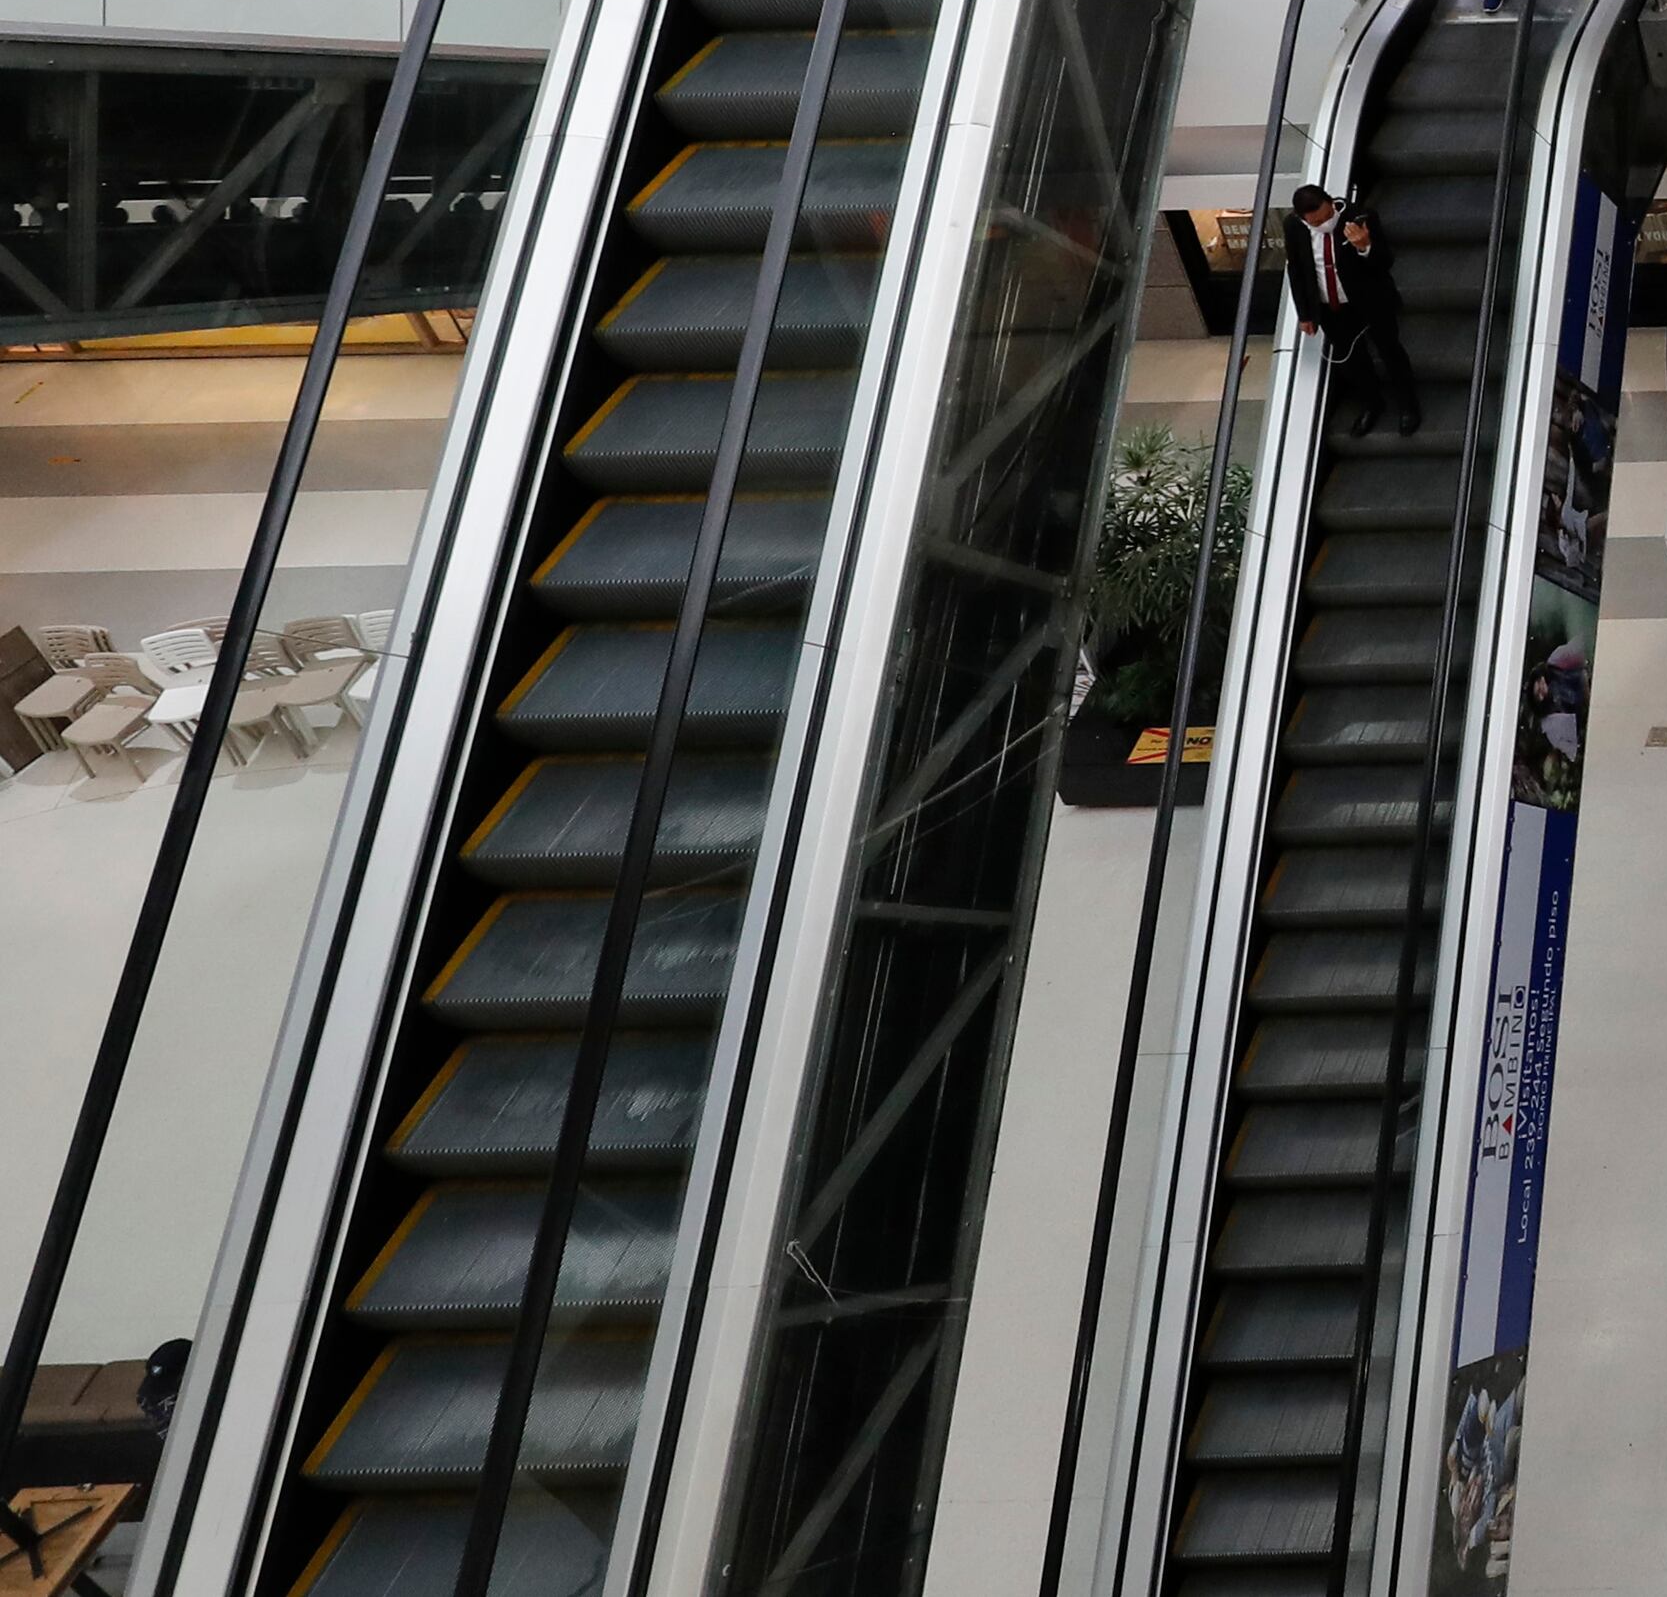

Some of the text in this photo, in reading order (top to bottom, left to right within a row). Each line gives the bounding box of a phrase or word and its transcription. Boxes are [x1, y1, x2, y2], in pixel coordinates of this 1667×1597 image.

[1589, 248, 1604, 330] BOSI
[1186, 737, 1212, 745] NO
[1482, 985, 1512, 1165] BOSI
[1498, 986, 1526, 1160] BAMBINO
[1518, 890, 1560, 1244] Local 239-244 segundo piso
